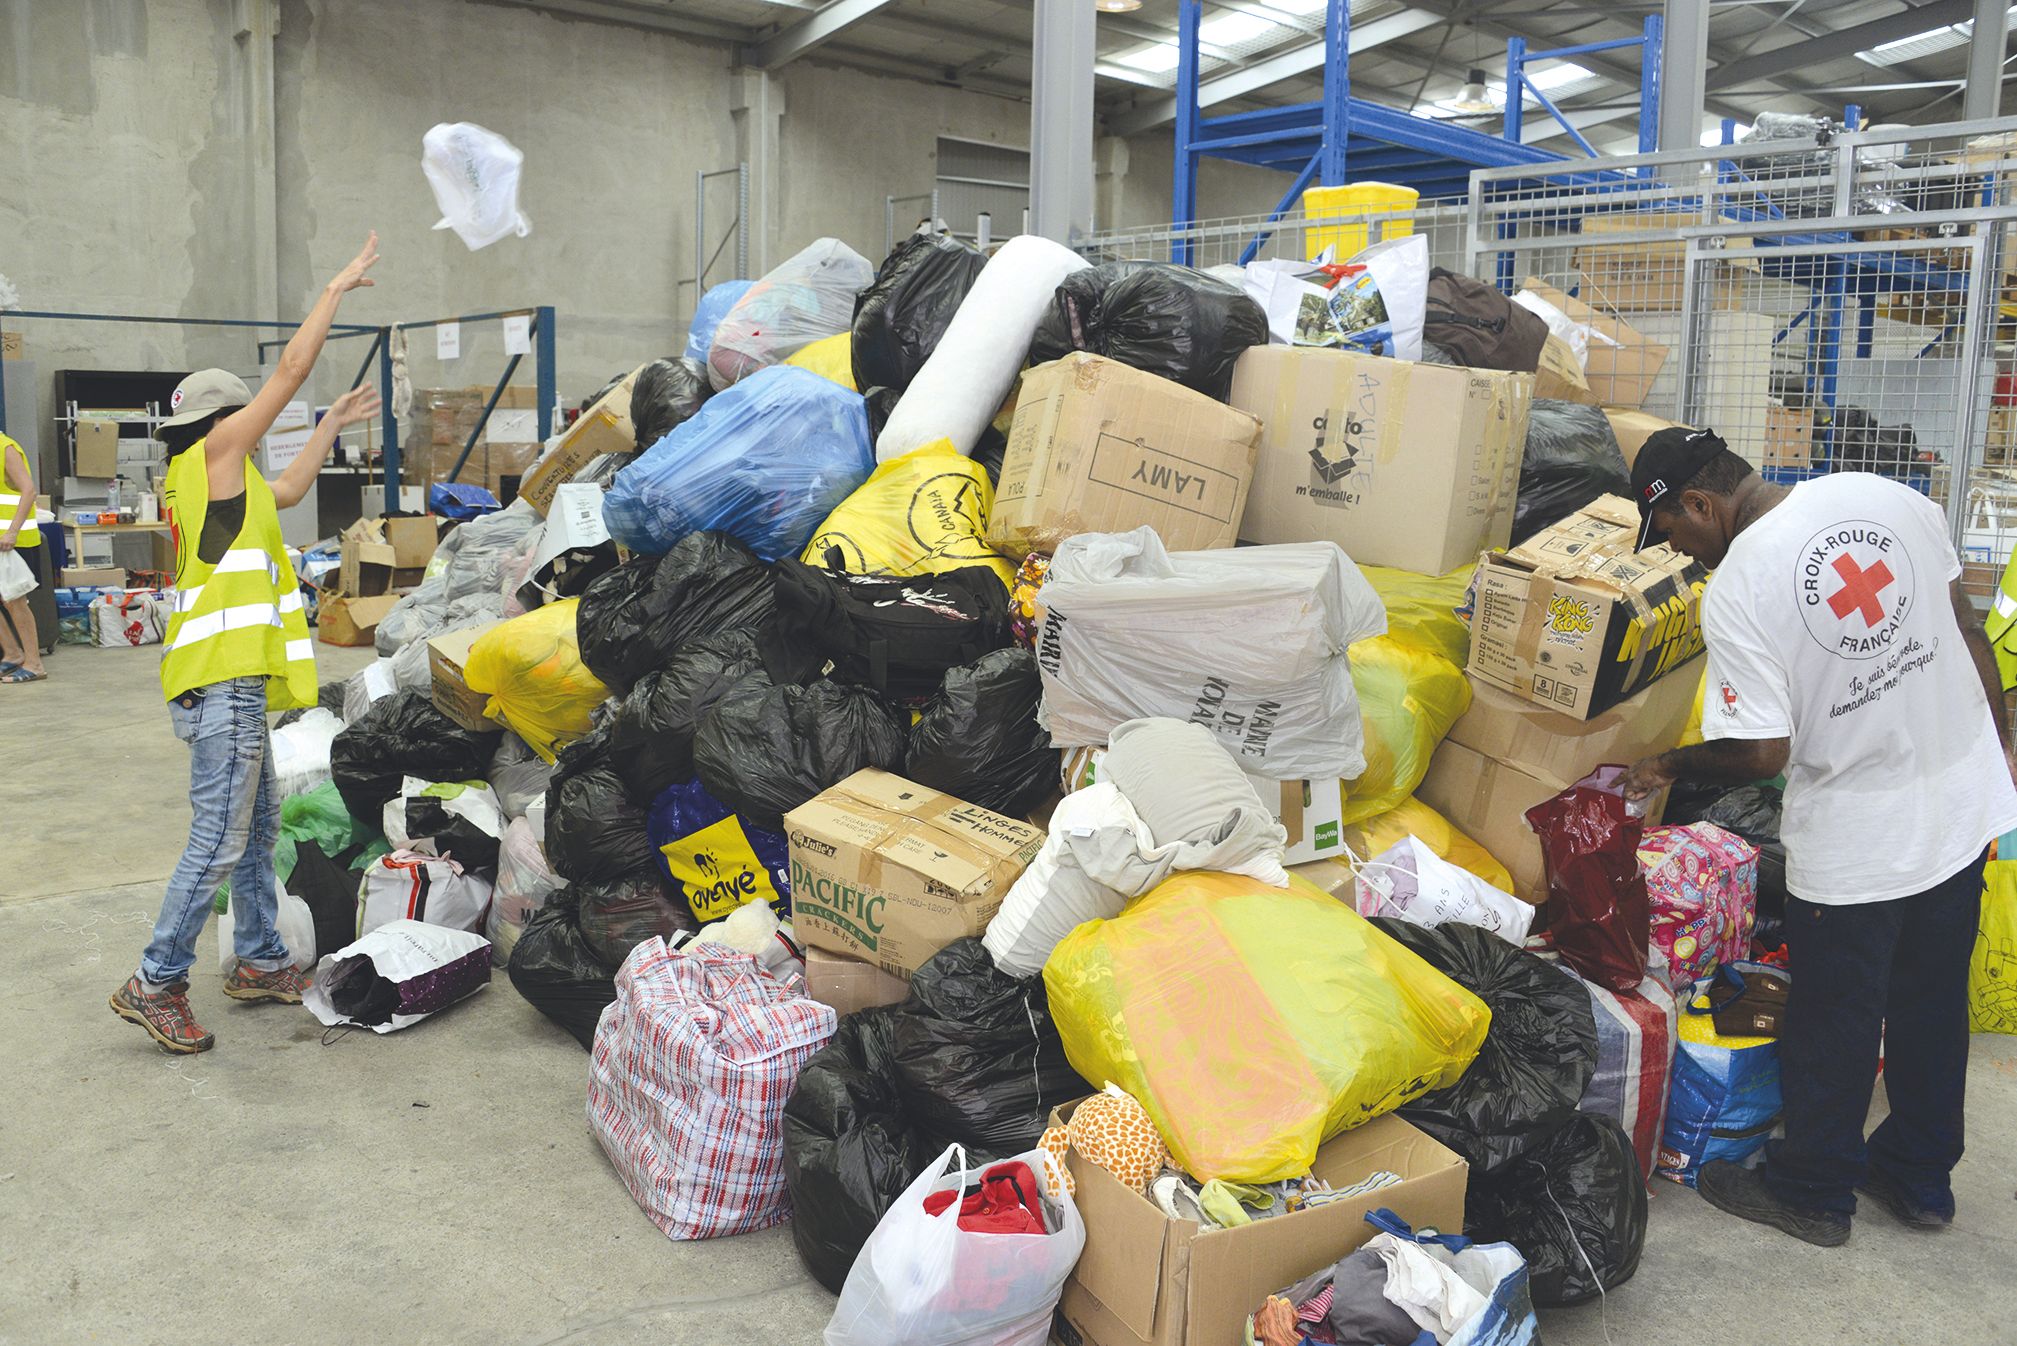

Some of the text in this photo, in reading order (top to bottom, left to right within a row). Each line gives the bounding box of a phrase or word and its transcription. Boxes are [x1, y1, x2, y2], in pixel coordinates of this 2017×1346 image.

[1313, 416, 1363, 436] cato
[1132, 459, 1207, 501] LAMY
[1804, 529, 1893, 606] CROIX-ROUGE
[1549, 595, 1589, 617] KING
[1552, 613, 1594, 633] KONG
[1849, 676, 1864, 696] Je
[1868, 665, 1885, 685] suis
[802, 838, 835, 857] Julie's
[791, 857, 887, 934] PACIFIC
[802, 904, 864, 939] CRACKERS
